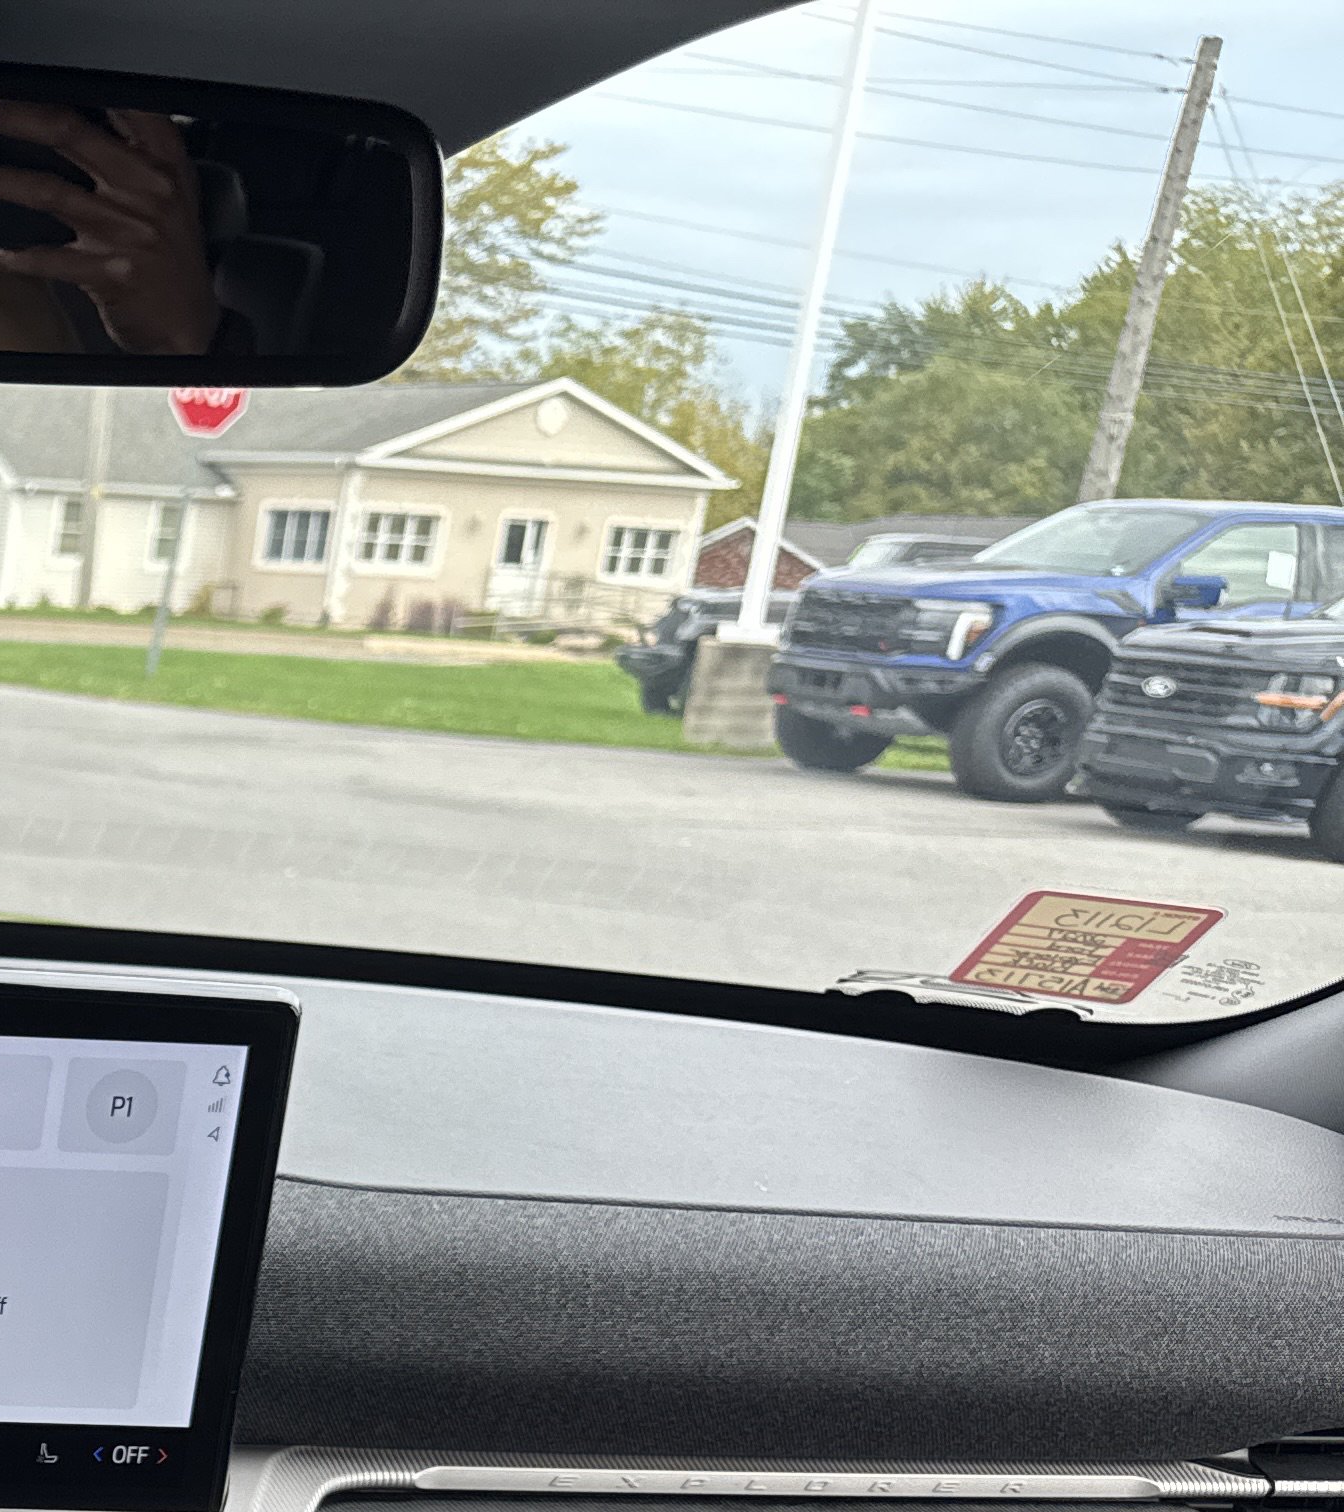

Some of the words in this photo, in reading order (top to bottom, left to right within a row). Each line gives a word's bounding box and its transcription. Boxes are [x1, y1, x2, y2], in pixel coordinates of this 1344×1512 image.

[110, 1096, 134, 1118] P1
[112, 1445, 149, 1464] OFF
[547, 1474, 1028, 1495] EXPLORER
